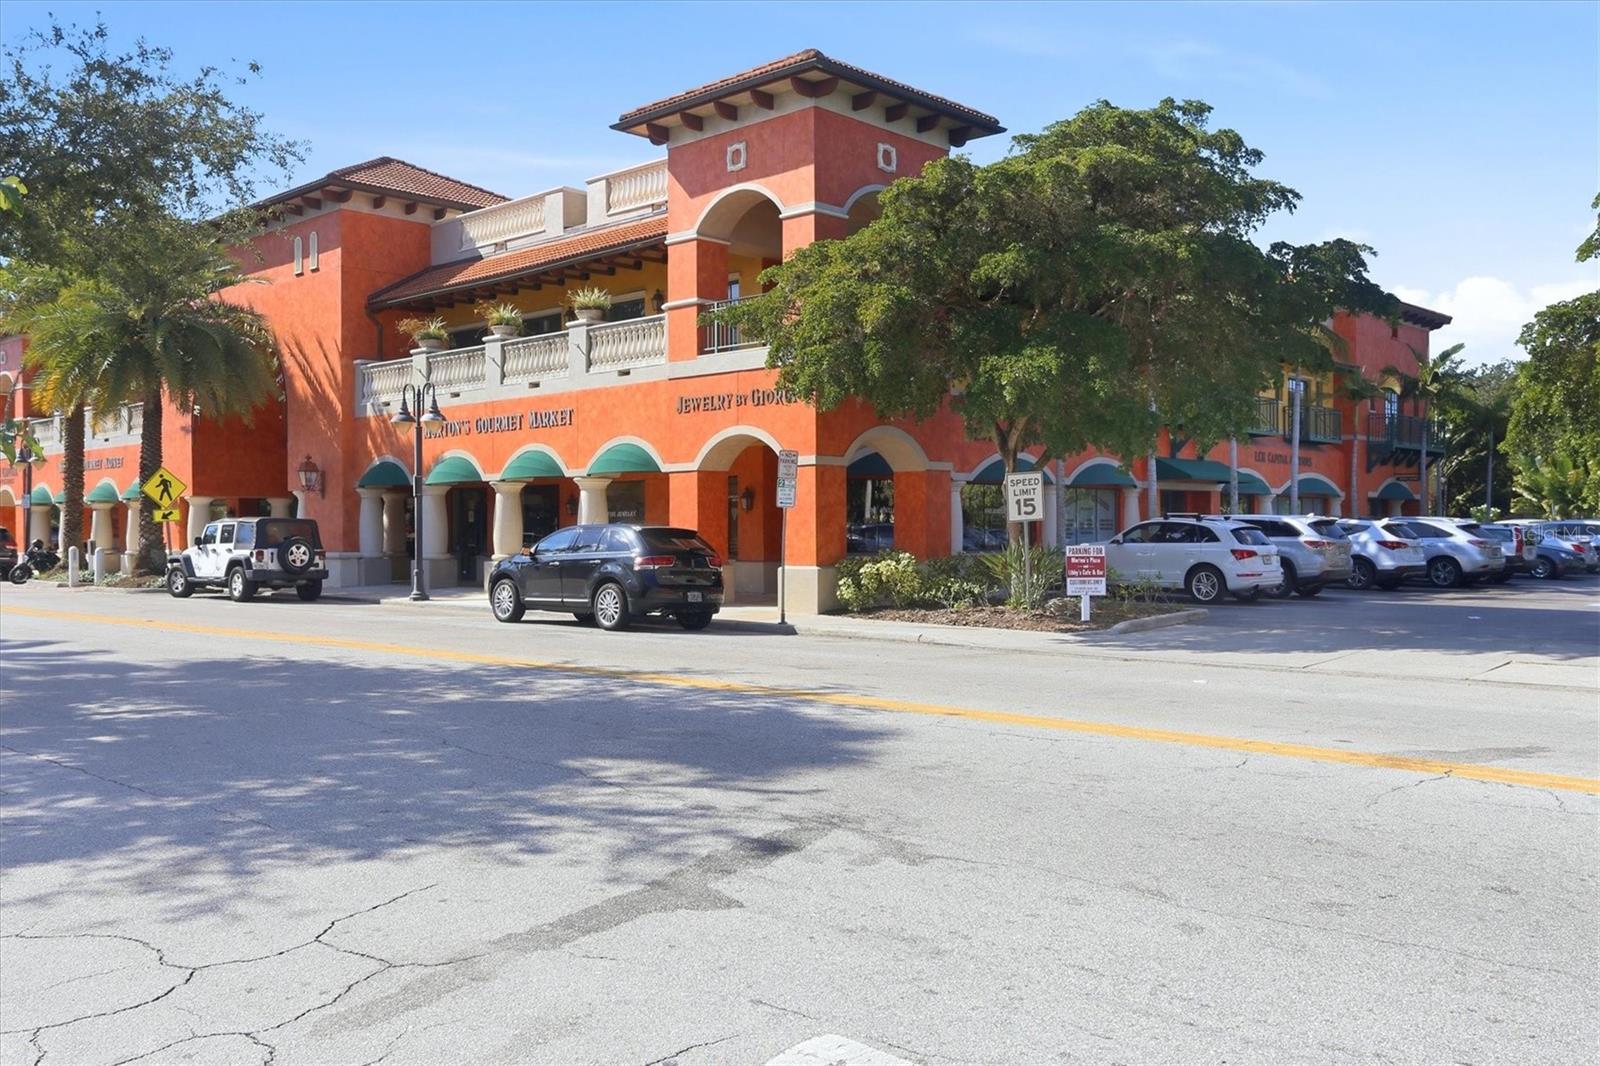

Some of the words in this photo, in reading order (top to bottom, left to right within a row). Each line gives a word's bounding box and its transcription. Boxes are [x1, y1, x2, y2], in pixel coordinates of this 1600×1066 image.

[677, 393, 734, 415] JEWELRY
[736, 394, 748, 407] BY
[476, 414, 524, 435] GOURMET
[529, 408, 575, 430] MARKET
[1010, 478, 1040, 487] SPEED
[1014, 488, 1036, 496] LIMIT
[1015, 498, 1036, 516] 15
[1068, 547, 1091, 555] PARKING
[1093, 547, 1103, 555] FOR
